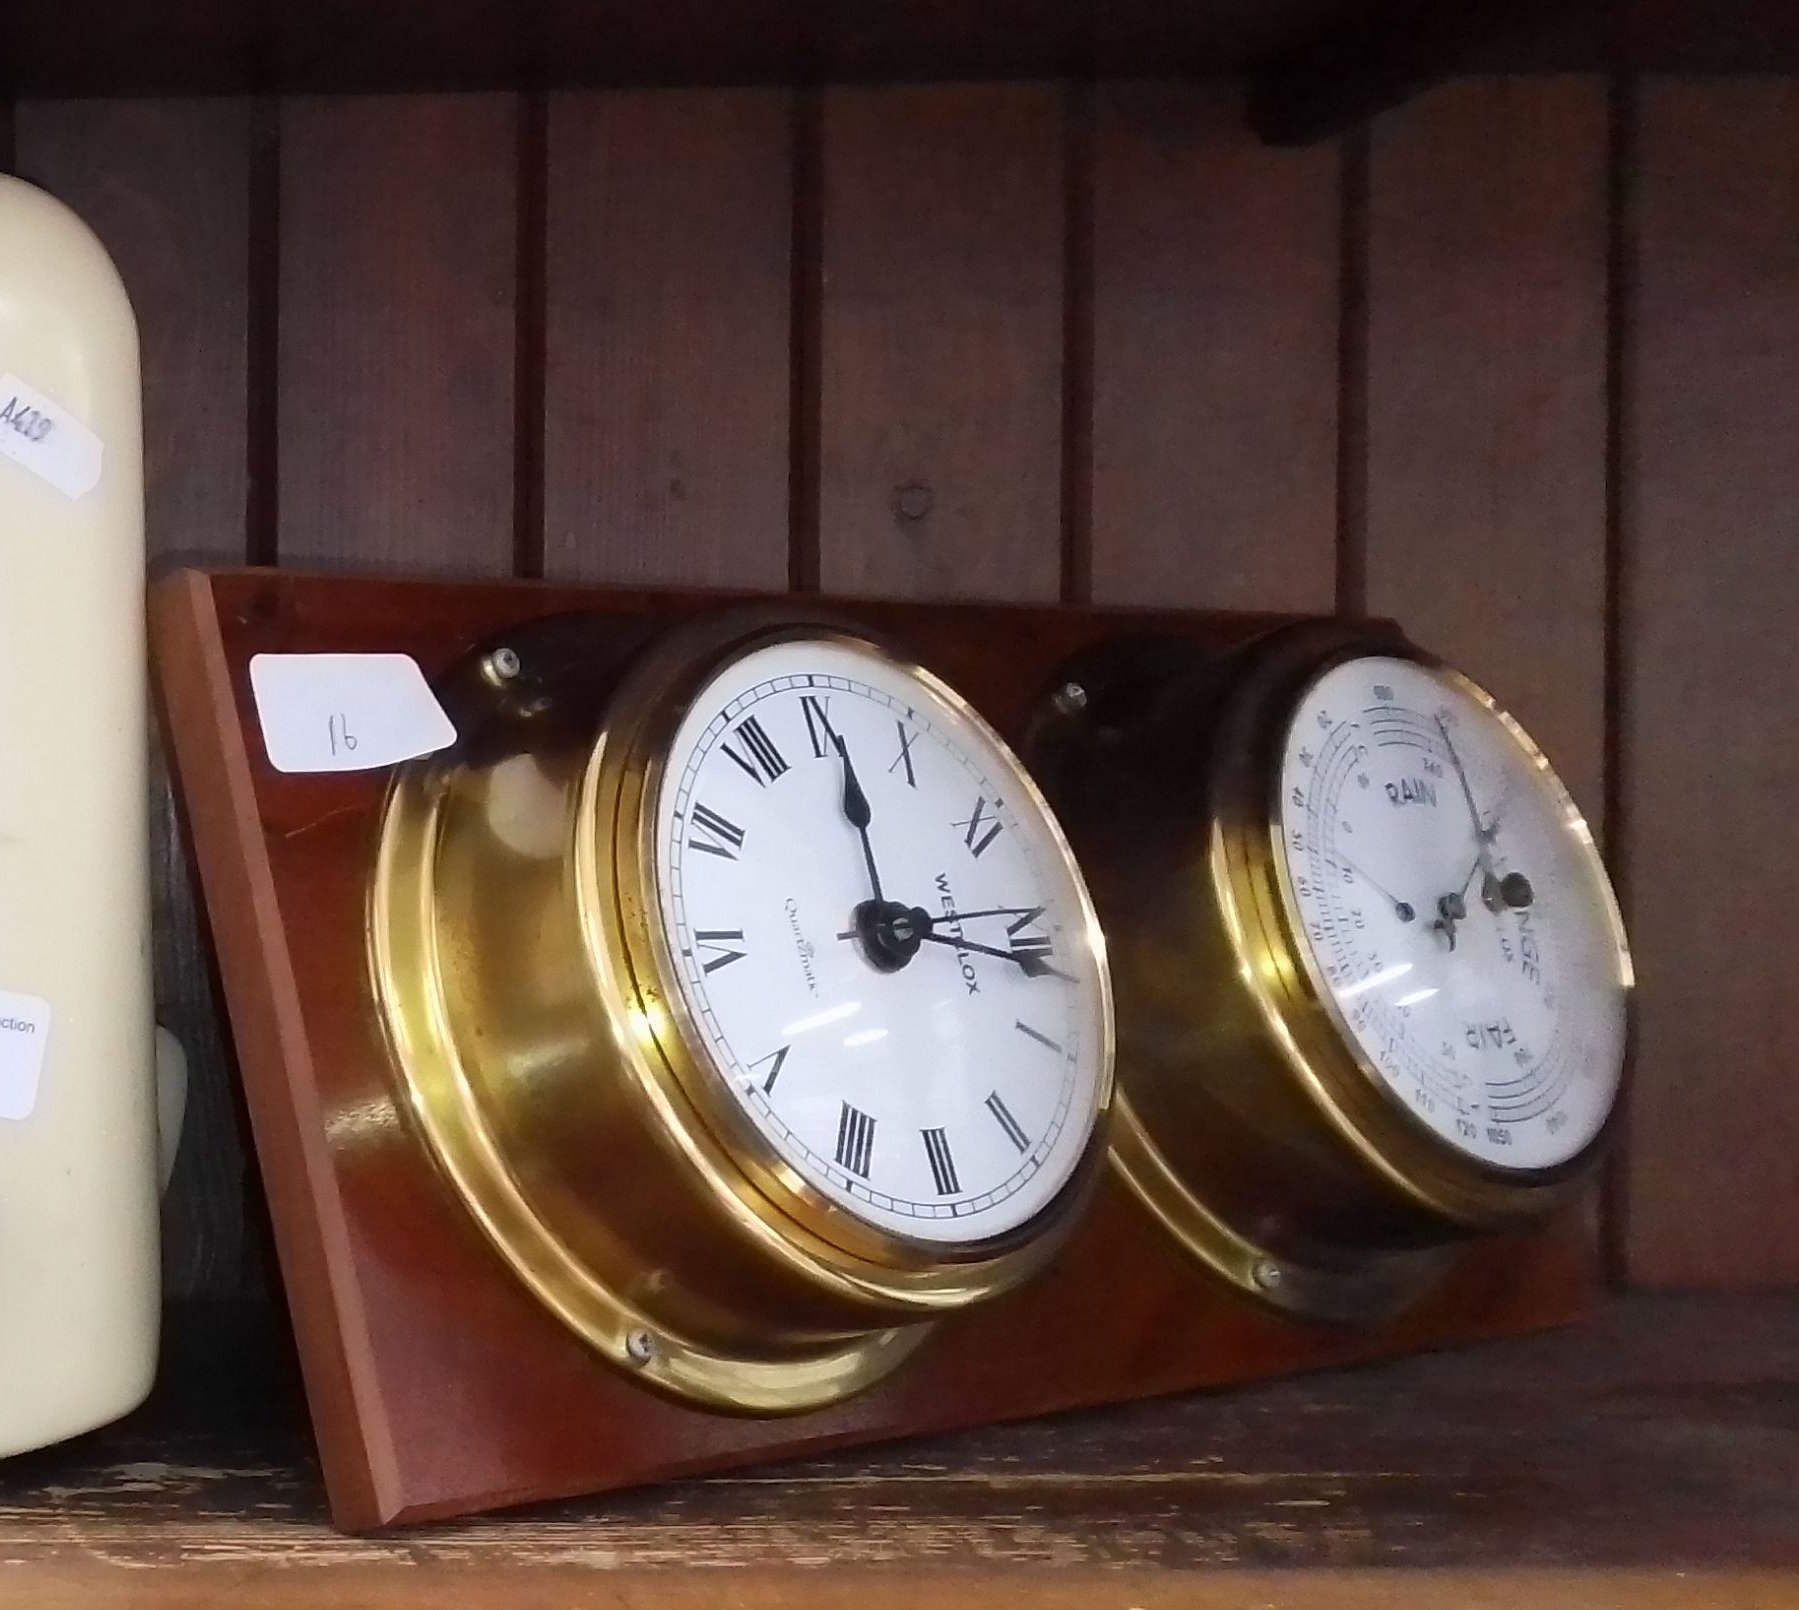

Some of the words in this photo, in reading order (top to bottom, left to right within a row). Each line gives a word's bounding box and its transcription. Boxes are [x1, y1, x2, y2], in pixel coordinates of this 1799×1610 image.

[328, 712, 358, 757] 16
[719, 714, 792, 788] VIII
[799, 695, 846, 758] IX
[889, 719, 920, 789] X
[1384, 777, 1438, 808] RAIN
[687, 801, 747, 861] VII
[952, 795, 1004, 860] XI
[691, 926, 749, 977] VI
[1464, 1017, 1517, 1050] FAIR
[747, 1043, 792, 1098] V
[834, 1099, 878, 1181] IIII
[985, 1090, 1032, 1155] II
[919, 1126, 962, 1197] III
